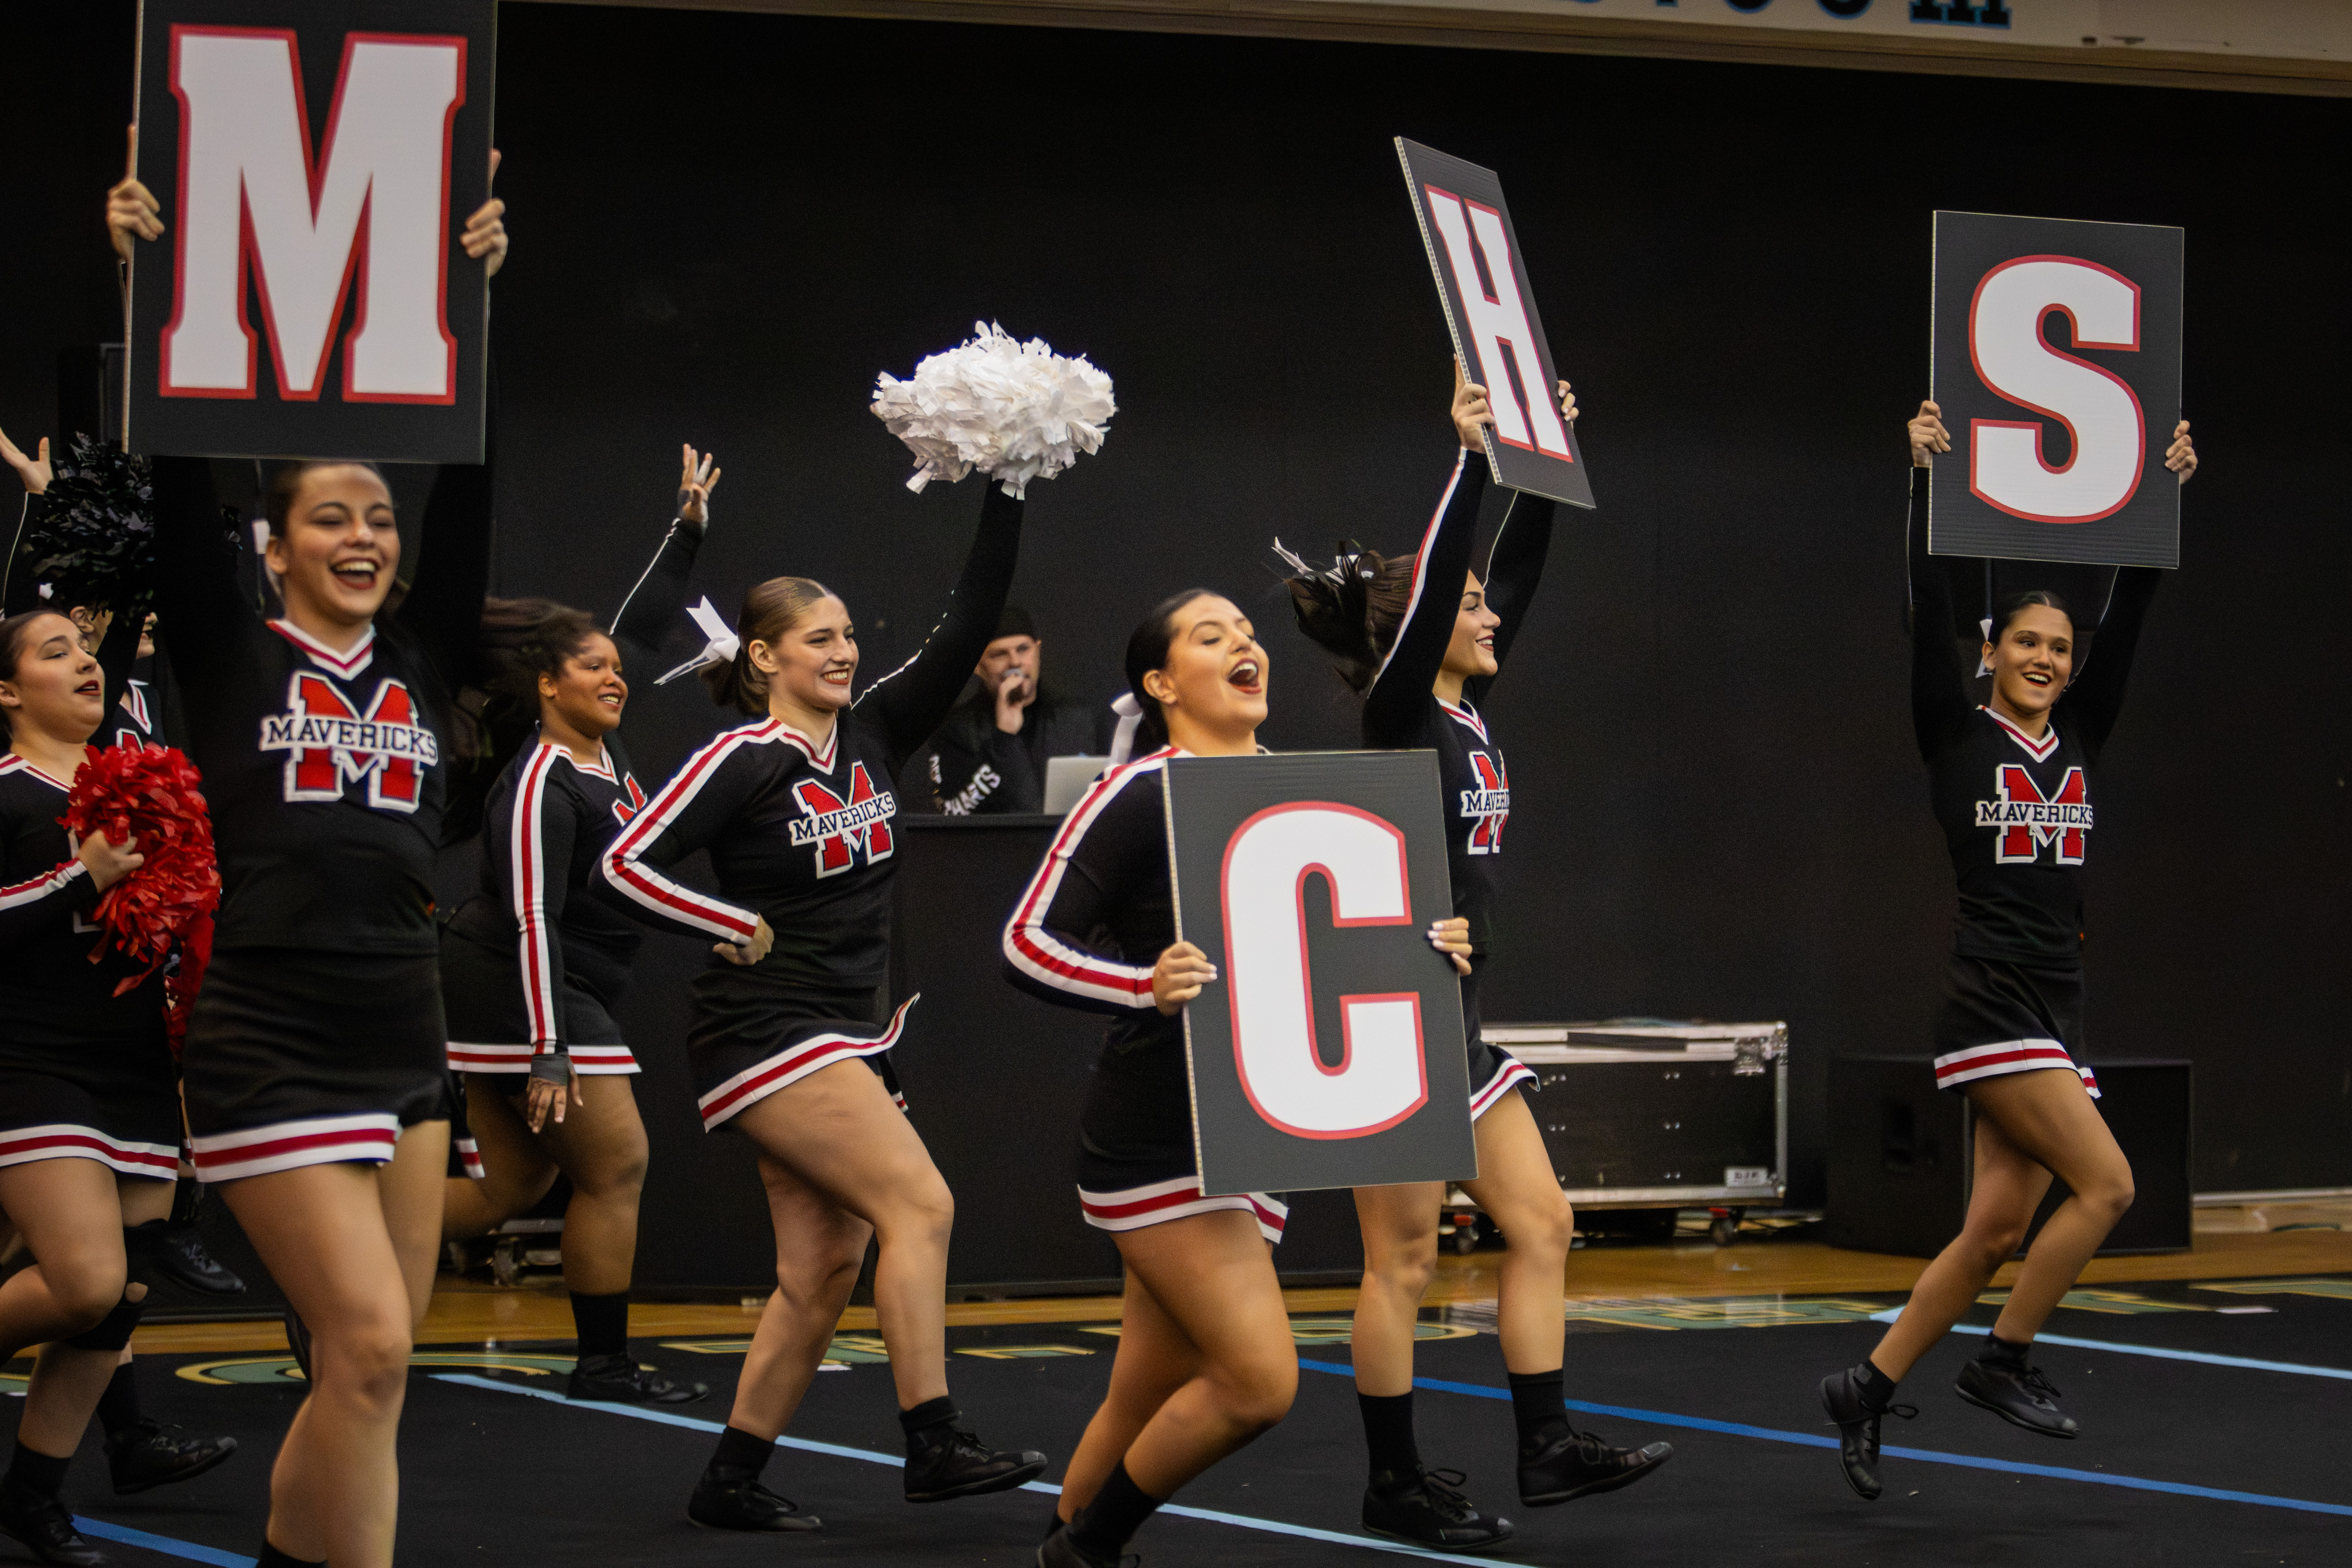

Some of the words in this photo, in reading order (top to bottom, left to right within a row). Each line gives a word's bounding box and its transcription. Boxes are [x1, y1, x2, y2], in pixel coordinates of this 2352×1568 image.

[158, 23, 467, 405] M
[1424, 183, 1573, 463] H
[1968, 254, 2146, 524] S
[267, 718, 437, 759] MAVERICKS
[793, 794, 895, 841] MAVERICKS
[1981, 803, 2093, 827] MAVERICKS
[1220, 800, 1429, 1140] C
